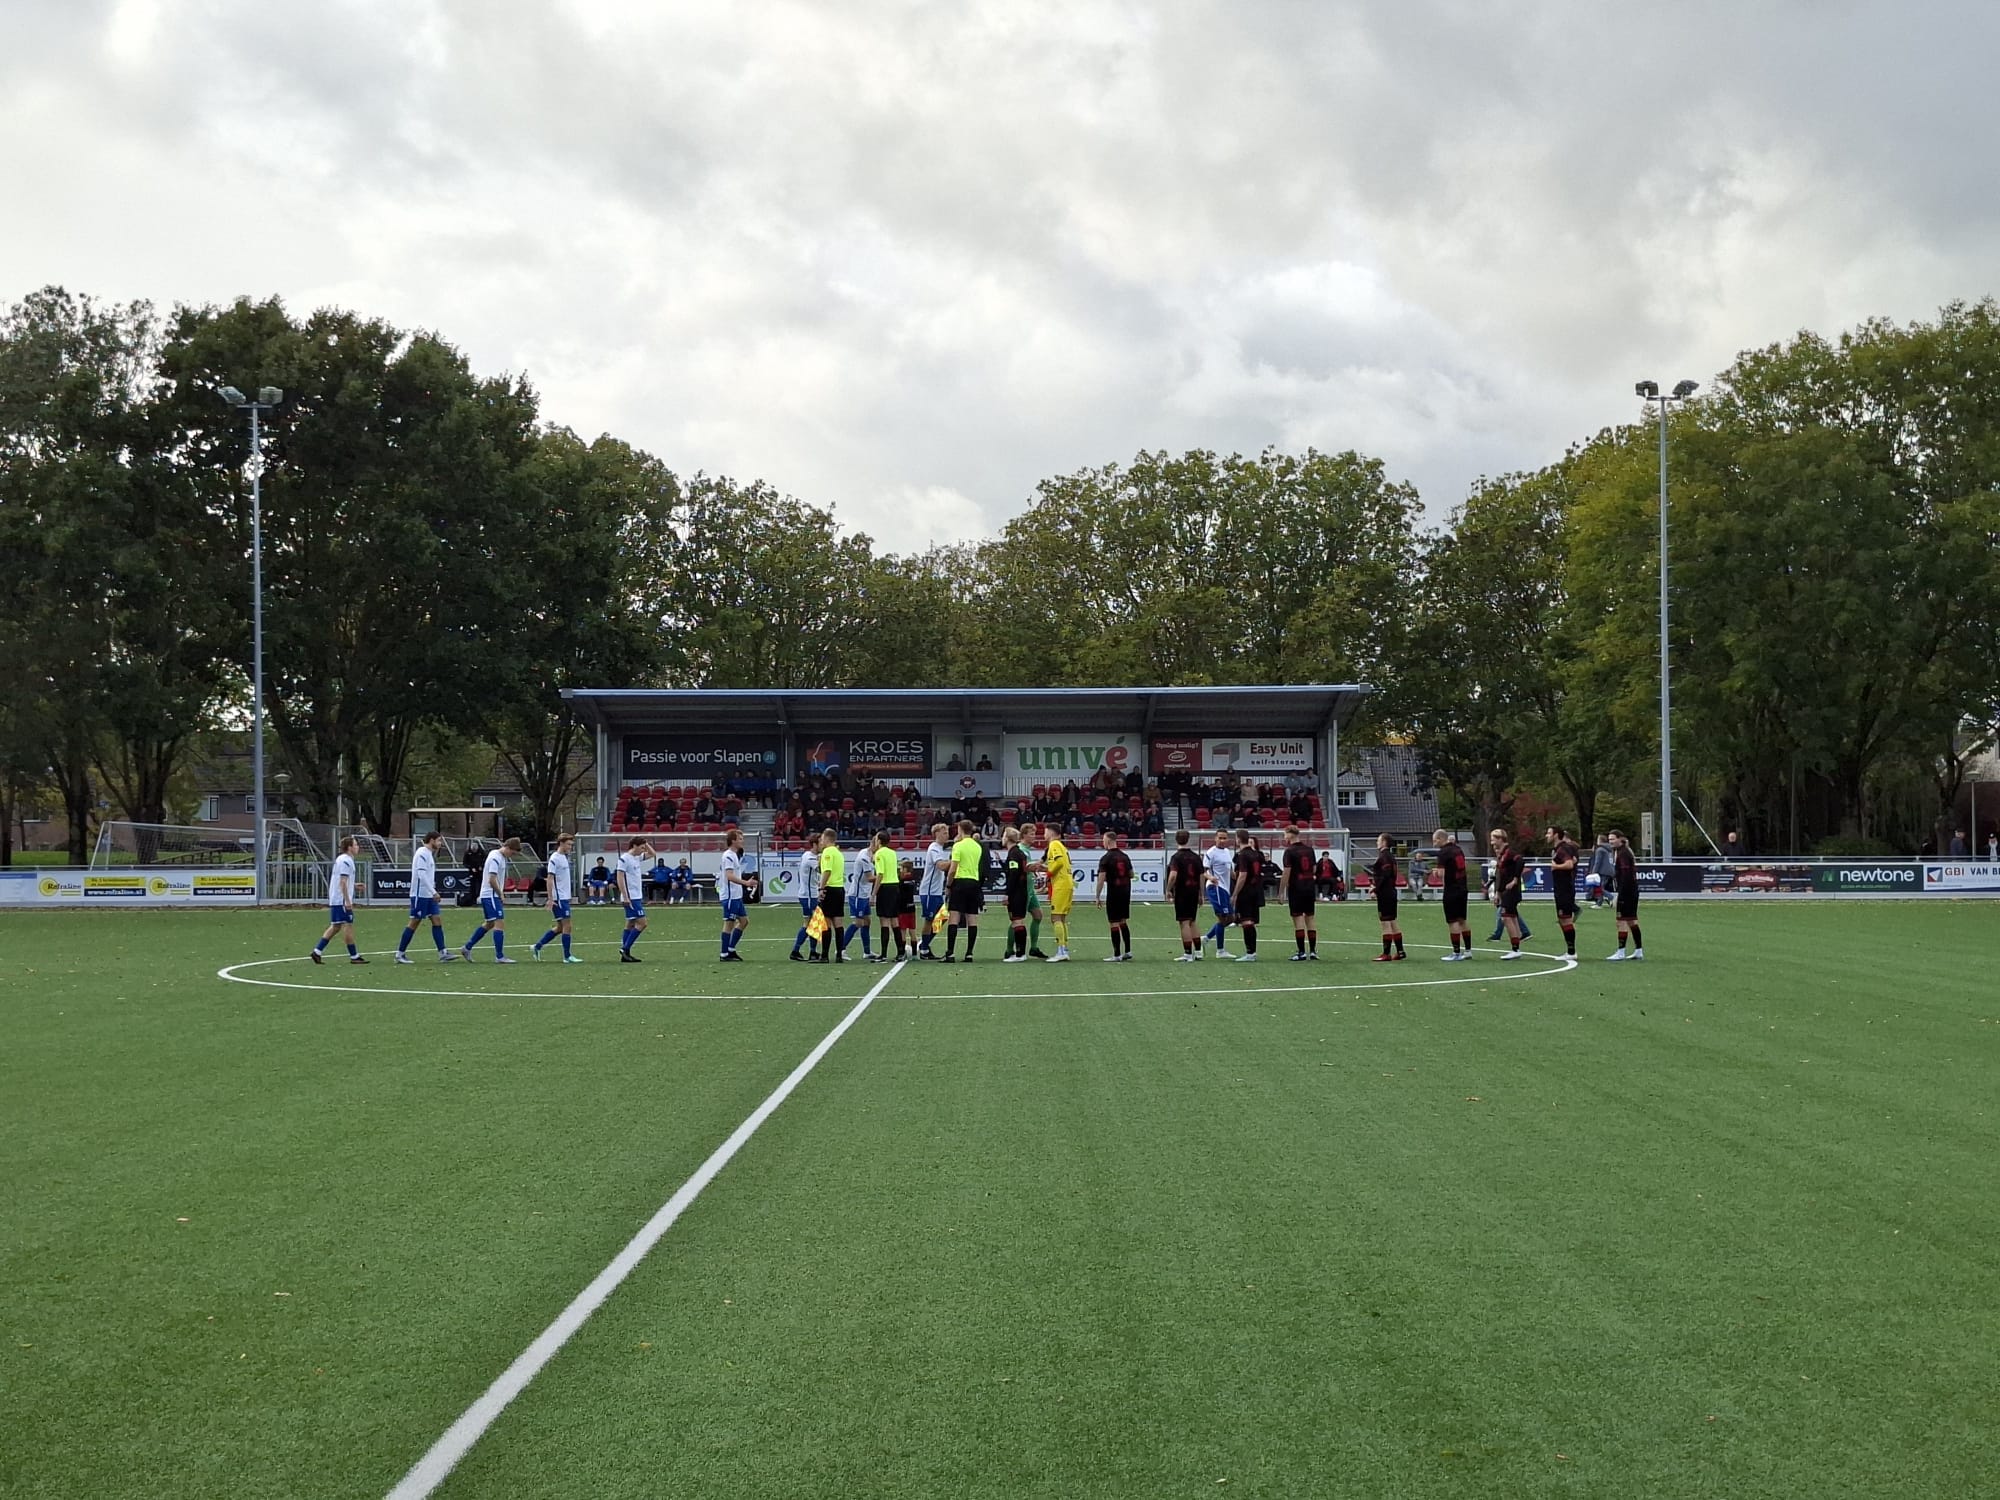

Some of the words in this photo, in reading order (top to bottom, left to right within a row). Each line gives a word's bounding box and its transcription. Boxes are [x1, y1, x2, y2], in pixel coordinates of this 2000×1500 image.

[849, 741, 924, 754] KROES
[1017, 736, 1128, 770] univé
[1250, 743, 1277, 757] Easy
[1280, 742, 1304, 754] Unit
[631, 749, 677, 763] Passie
[680, 752, 711, 763] voor
[714, 749, 762, 766] Slapen
[849, 755, 864, 763] EN
[866, 755, 924, 763] PARTNERS
[1251, 758, 1306, 767] self-storage
[1839, 867, 1915, 882] newtone
[1944, 867, 1965, 876] GBI
[1970, 867, 1988, 876] VAN
[378, 880, 394, 889] Van
